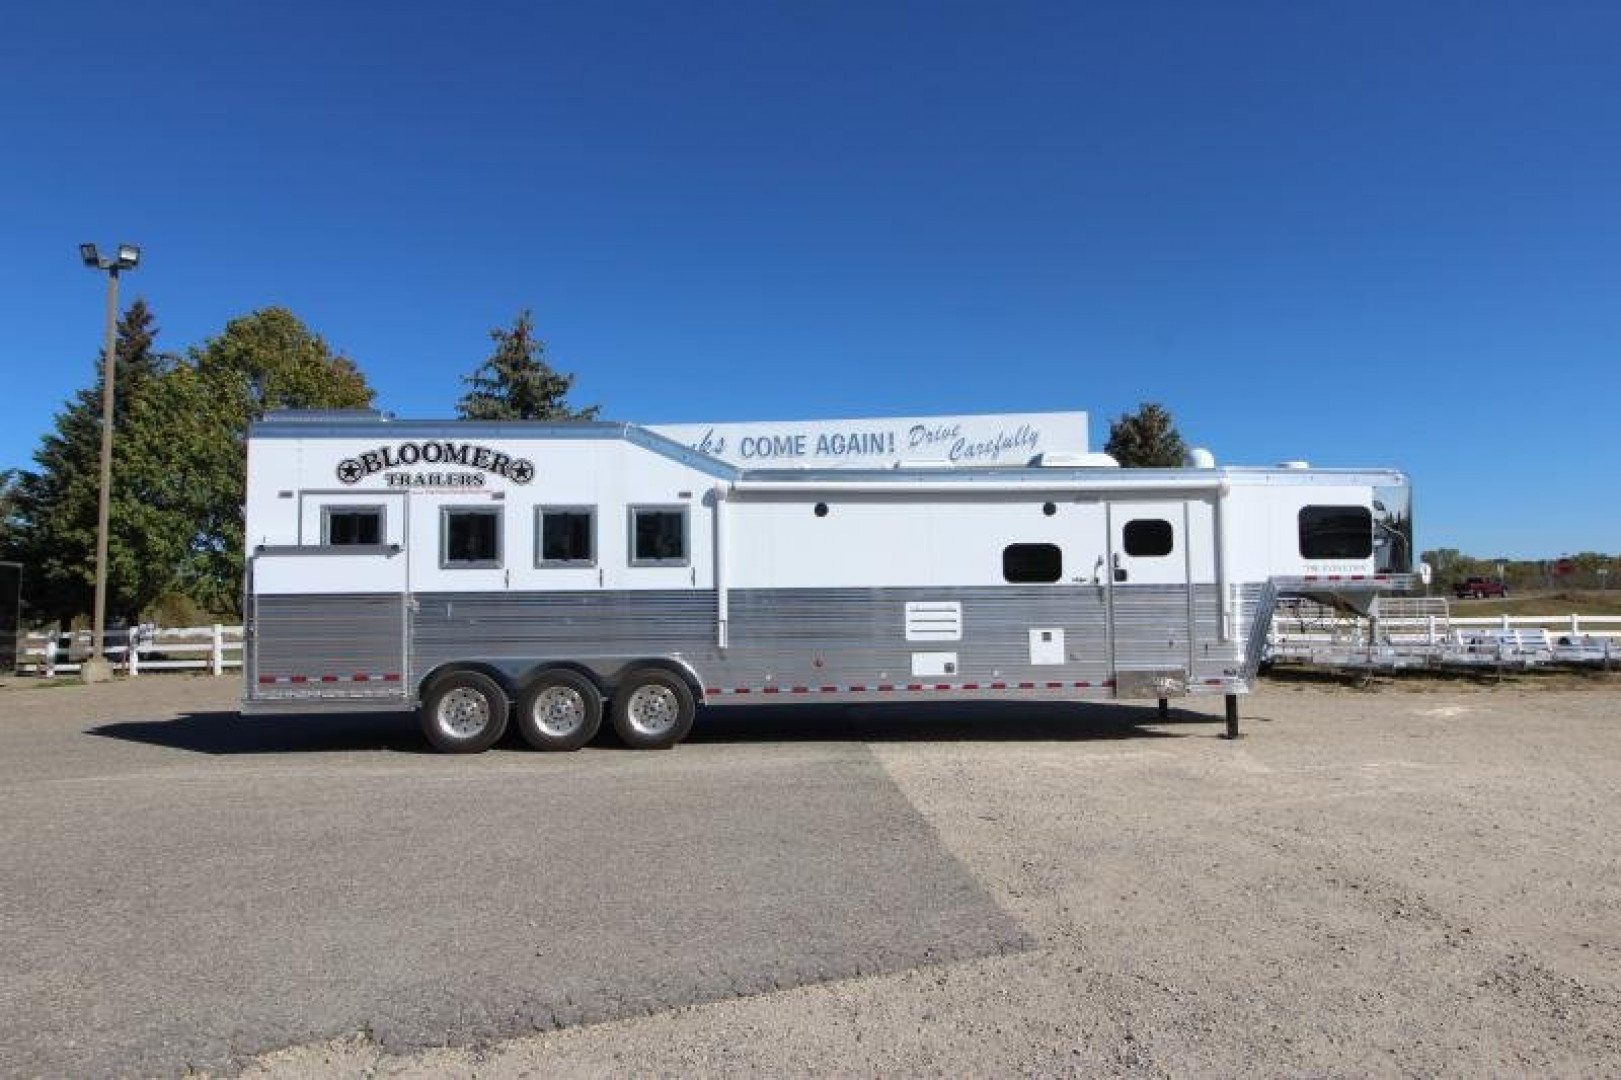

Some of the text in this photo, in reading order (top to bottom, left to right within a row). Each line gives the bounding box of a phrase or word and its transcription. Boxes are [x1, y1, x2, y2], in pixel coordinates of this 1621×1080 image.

[692, 427, 895, 458] ks COME AGAIN!
[908, 424, 960, 448] Drive
[949, 423, 1039, 461] Carefully
[359, 441, 511, 478] BLOOMER
[384, 471, 487, 487] TRAILERS
